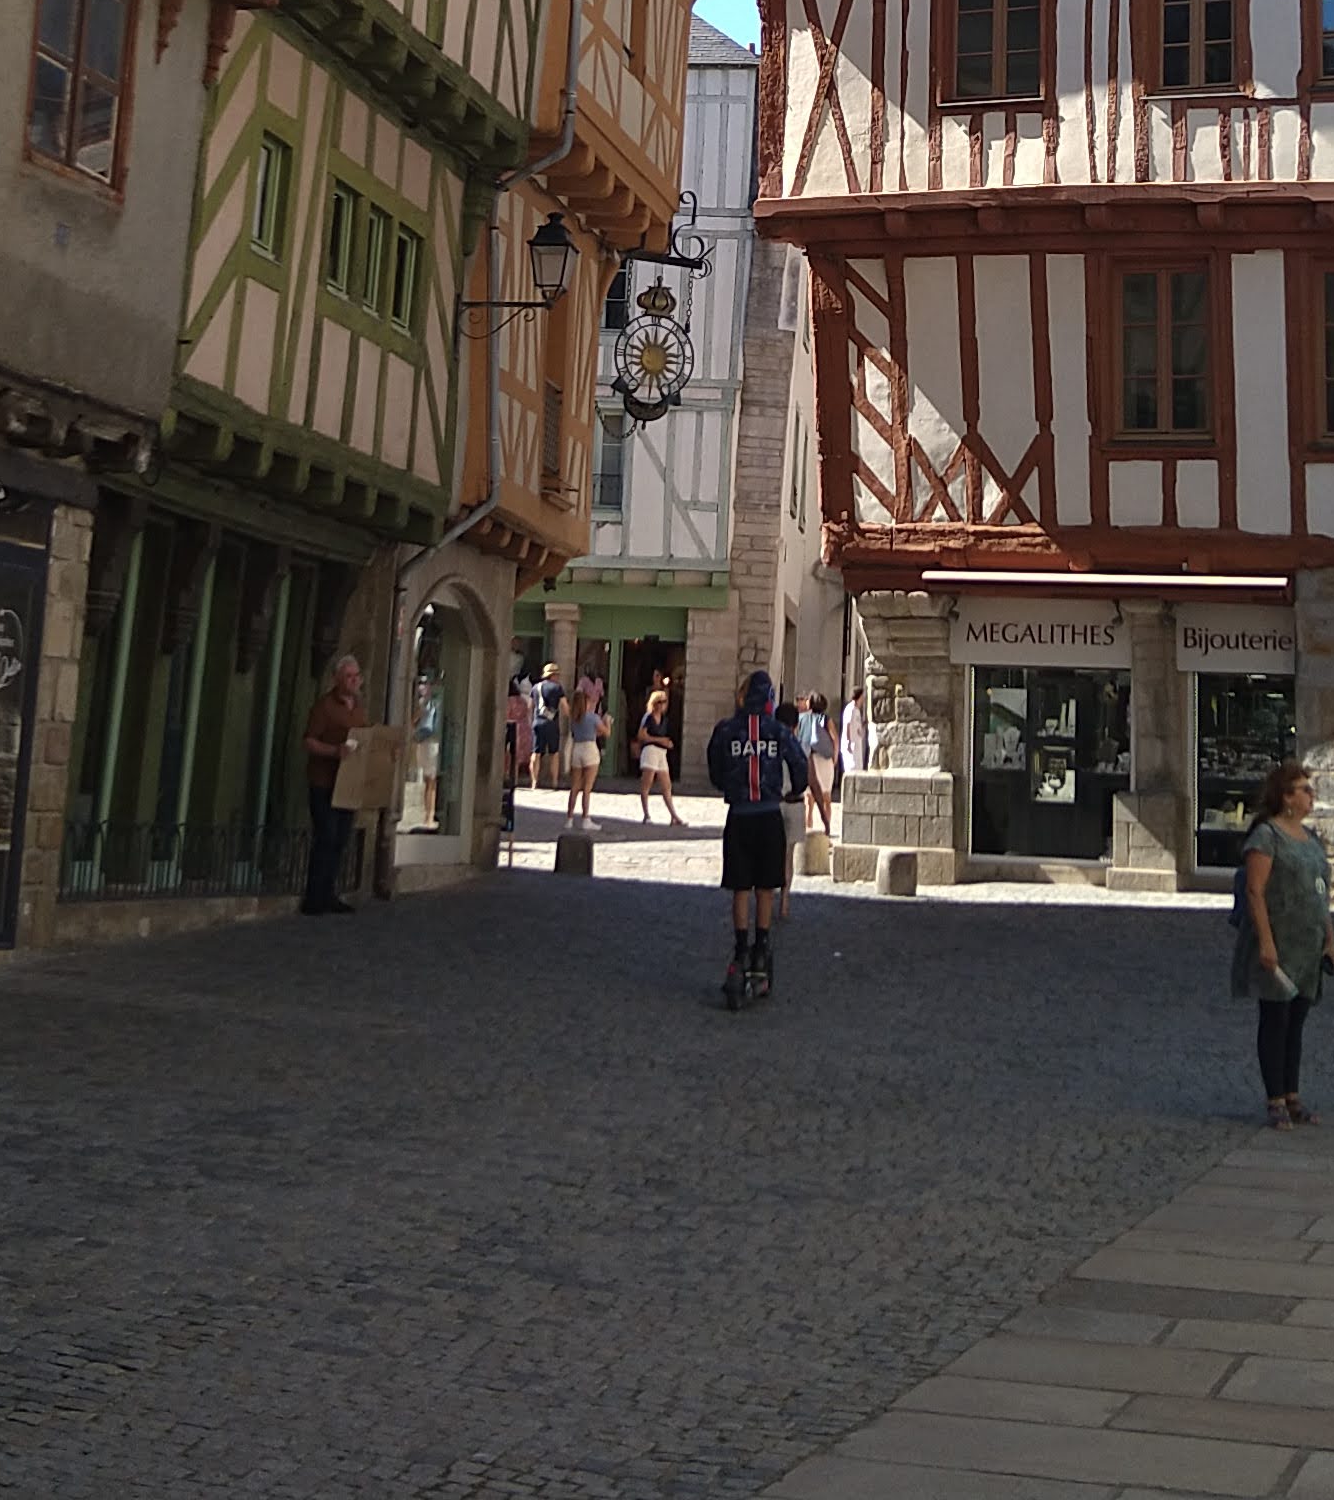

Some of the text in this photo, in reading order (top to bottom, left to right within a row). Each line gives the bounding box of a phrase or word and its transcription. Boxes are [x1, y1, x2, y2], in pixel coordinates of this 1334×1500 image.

[966, 622, 1116, 646] MEGALITHES
[1183, 627, 1293, 655] Bijouterie
[731, 740, 778, 757] BAPE
